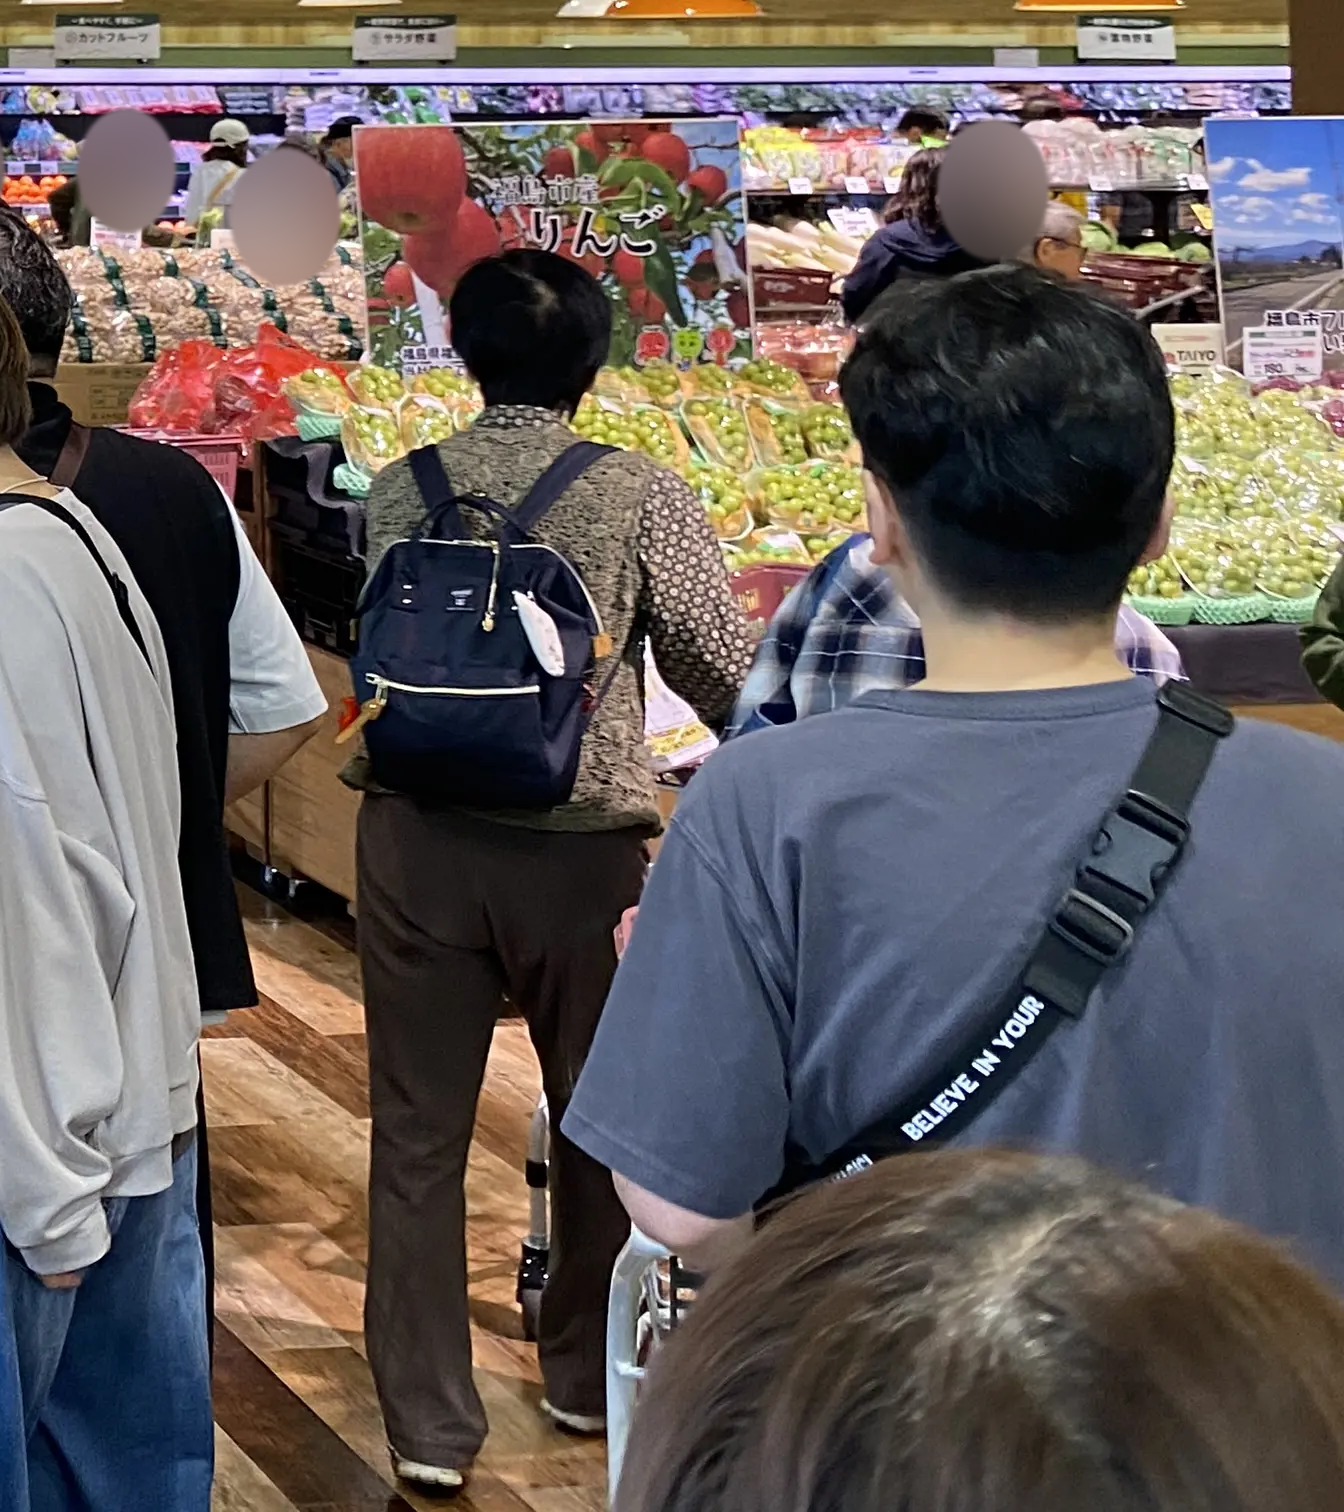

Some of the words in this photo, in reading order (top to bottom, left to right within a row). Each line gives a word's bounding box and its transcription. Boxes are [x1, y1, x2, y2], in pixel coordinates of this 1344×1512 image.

[491, 173, 602, 206] 福島市産
[530, 205, 667, 258] りんご
[1175, 350, 1217, 362] TAIYO
[900, 1073, 980, 1141] BELIEVE
[971, 1048, 1001, 1076] IN
[992, 995, 1045, 1049] YOUR
